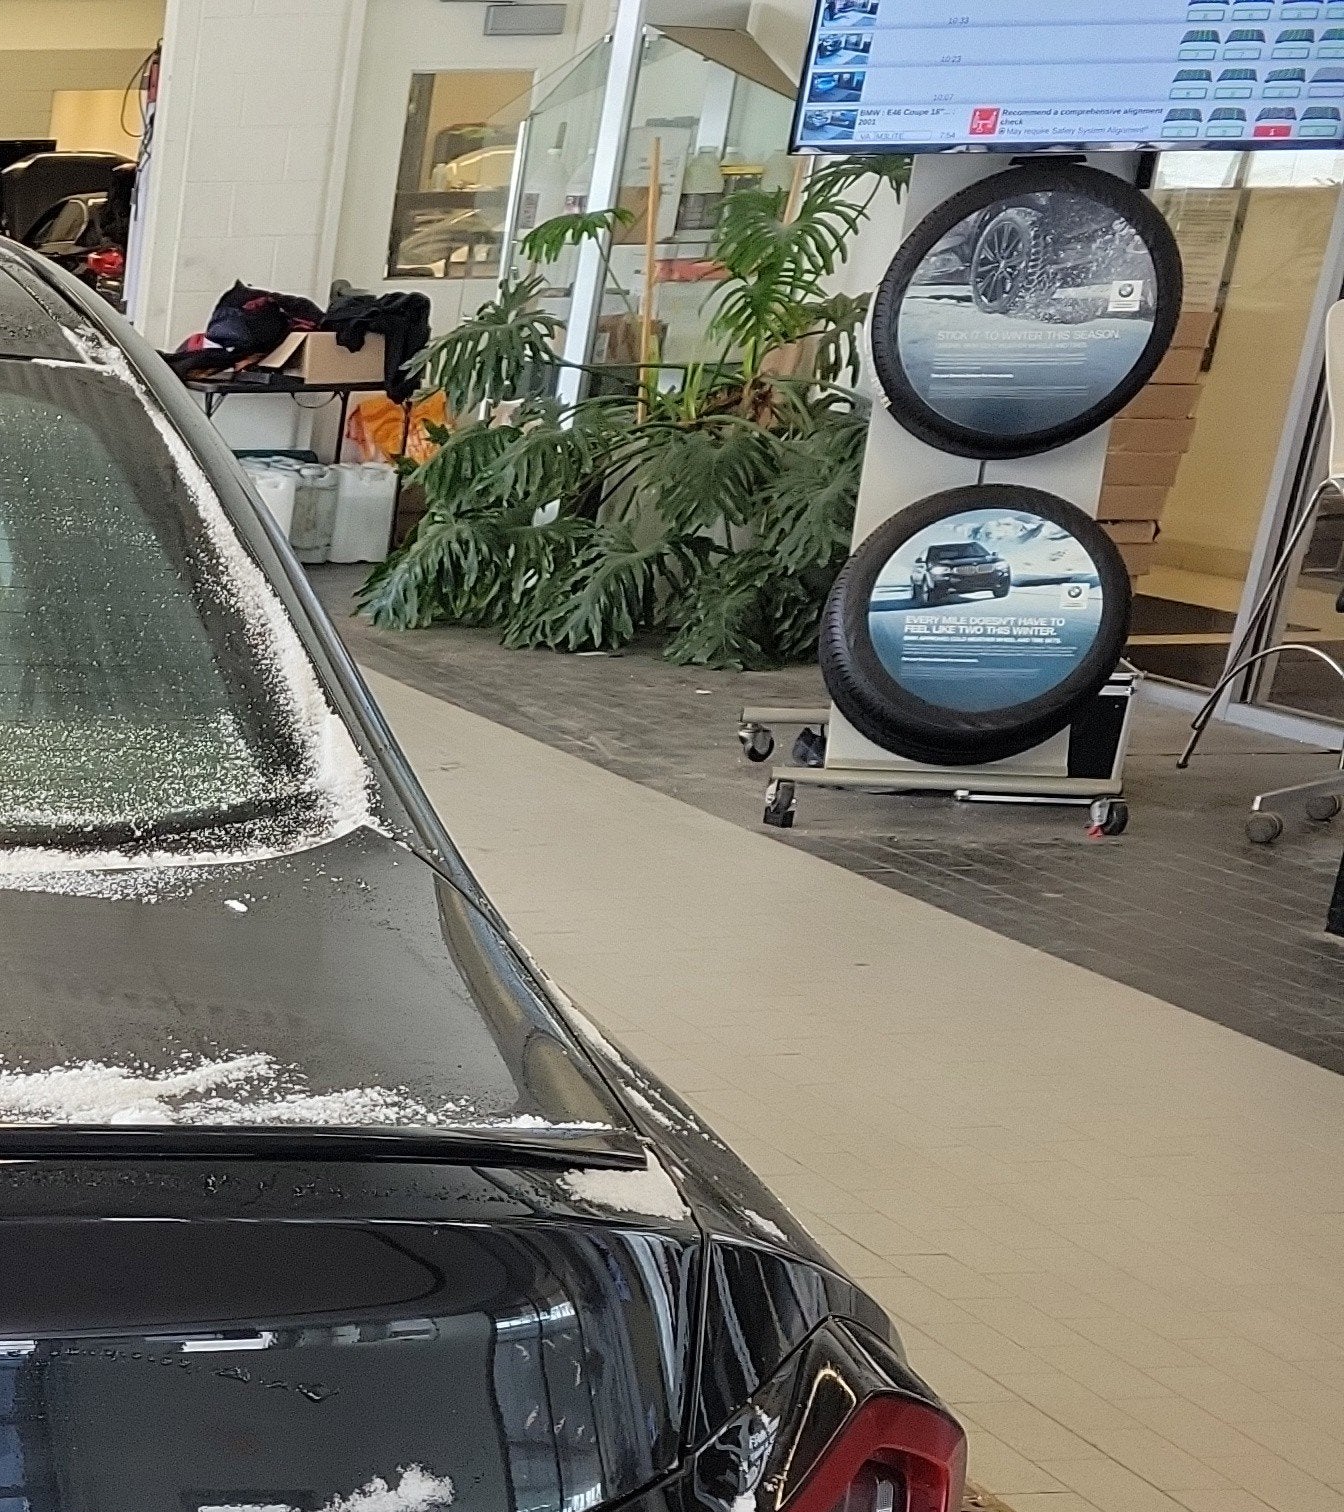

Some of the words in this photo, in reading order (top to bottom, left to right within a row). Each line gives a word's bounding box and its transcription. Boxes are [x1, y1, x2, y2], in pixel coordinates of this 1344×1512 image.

[1060, 108, 1121, 116] comprehensive
[1002, 331, 1042, 340] WINTER
[1046, 330, 1070, 340] THIS
[906, 615, 939, 624] EVERY
[942, 616, 968, 624] MILE
[1018, 617, 1048, 626] HAVE
[1050, 617, 1066, 626] TO
[904, 624, 931, 633] FEEL
[932, 625, 956, 634] LIKE
[958, 625, 985, 635] TWO
[986, 626, 1011, 635] THIS
